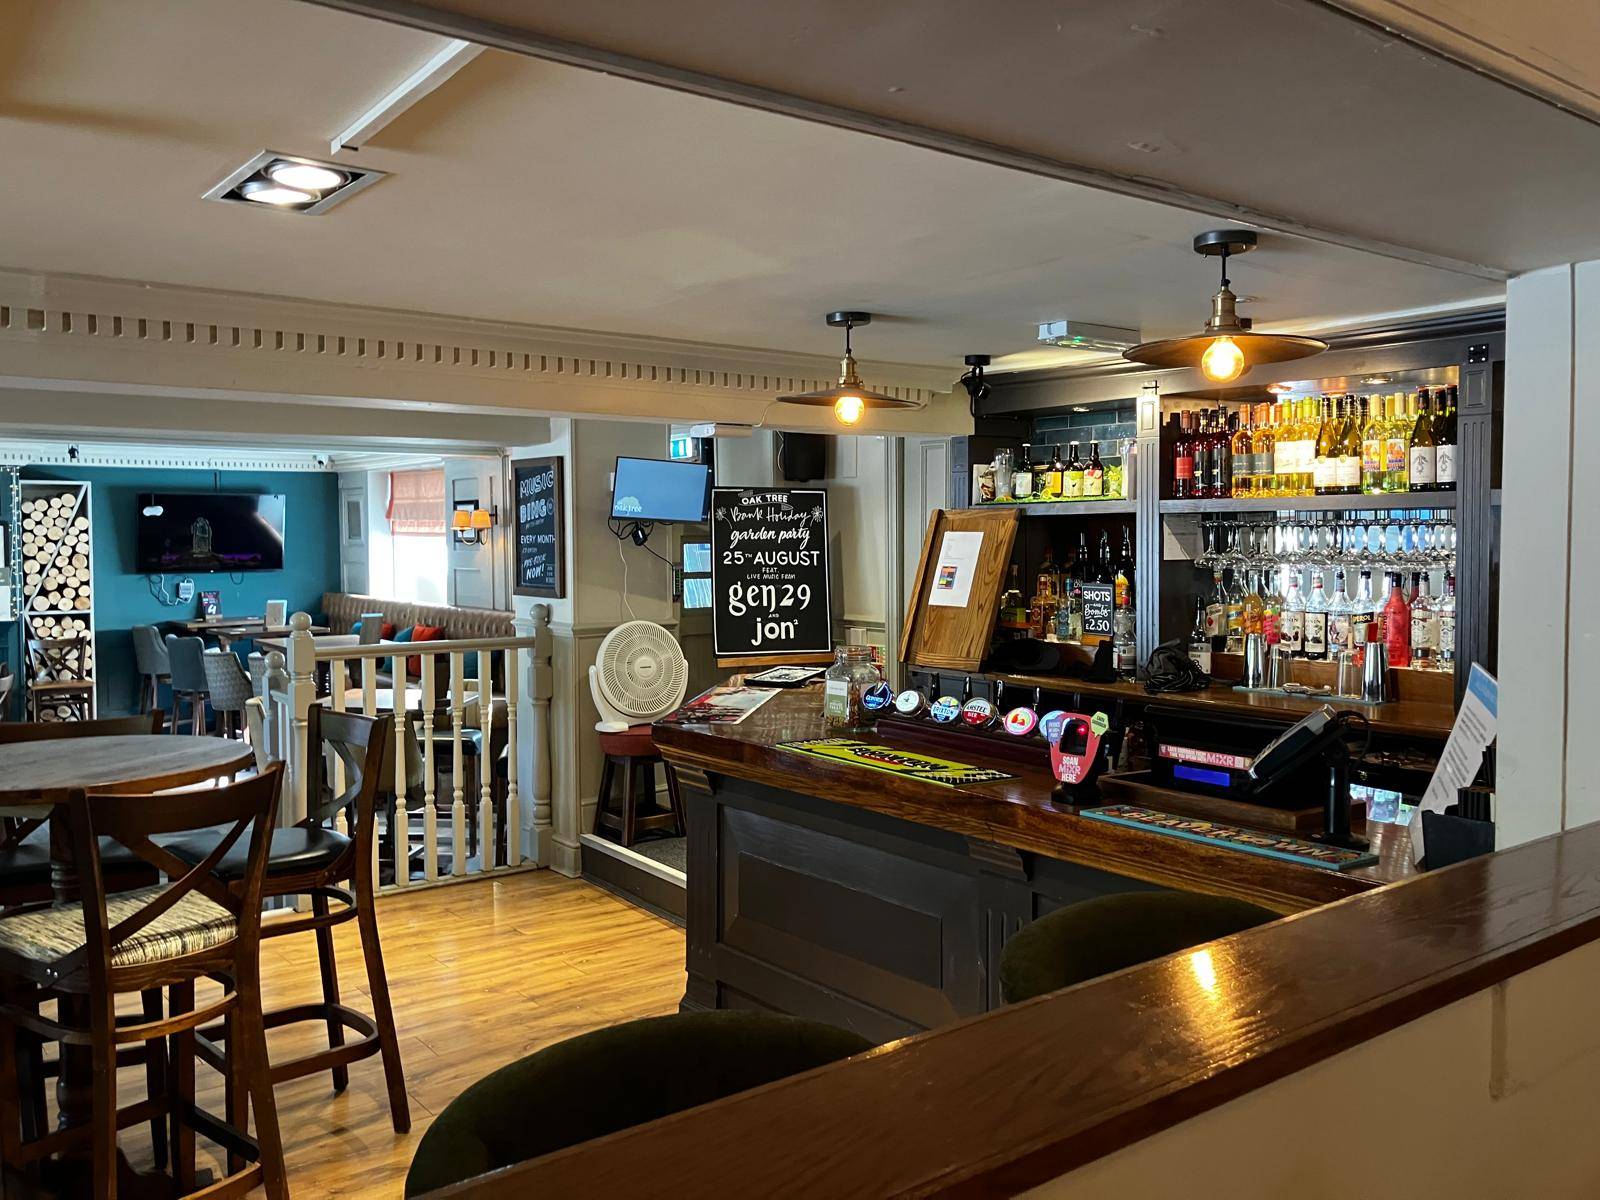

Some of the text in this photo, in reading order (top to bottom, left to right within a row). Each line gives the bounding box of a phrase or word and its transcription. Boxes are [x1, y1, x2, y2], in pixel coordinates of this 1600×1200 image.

[520, 470, 554, 498] MUSIC
[741, 494, 788, 505] OAK TREE
[730, 506, 811, 527] Bank Holiday
[520, 534, 536, 544] EVERY
[730, 526, 810, 550] garden party
[753, 551, 820, 566] AUGUST
[526, 563, 545, 581] NOW!
[1083, 591, 1111, 601] SHOTS
[1084, 604, 1111, 617] Bombs
[1085, 619, 1110, 631] £2.50
[932, 706, 954, 716] BRIXTON
[966, 704, 987, 713] AMSTEL
[1062, 756, 1078, 766] SCAN
[1061, 773, 1076, 782] HERE
